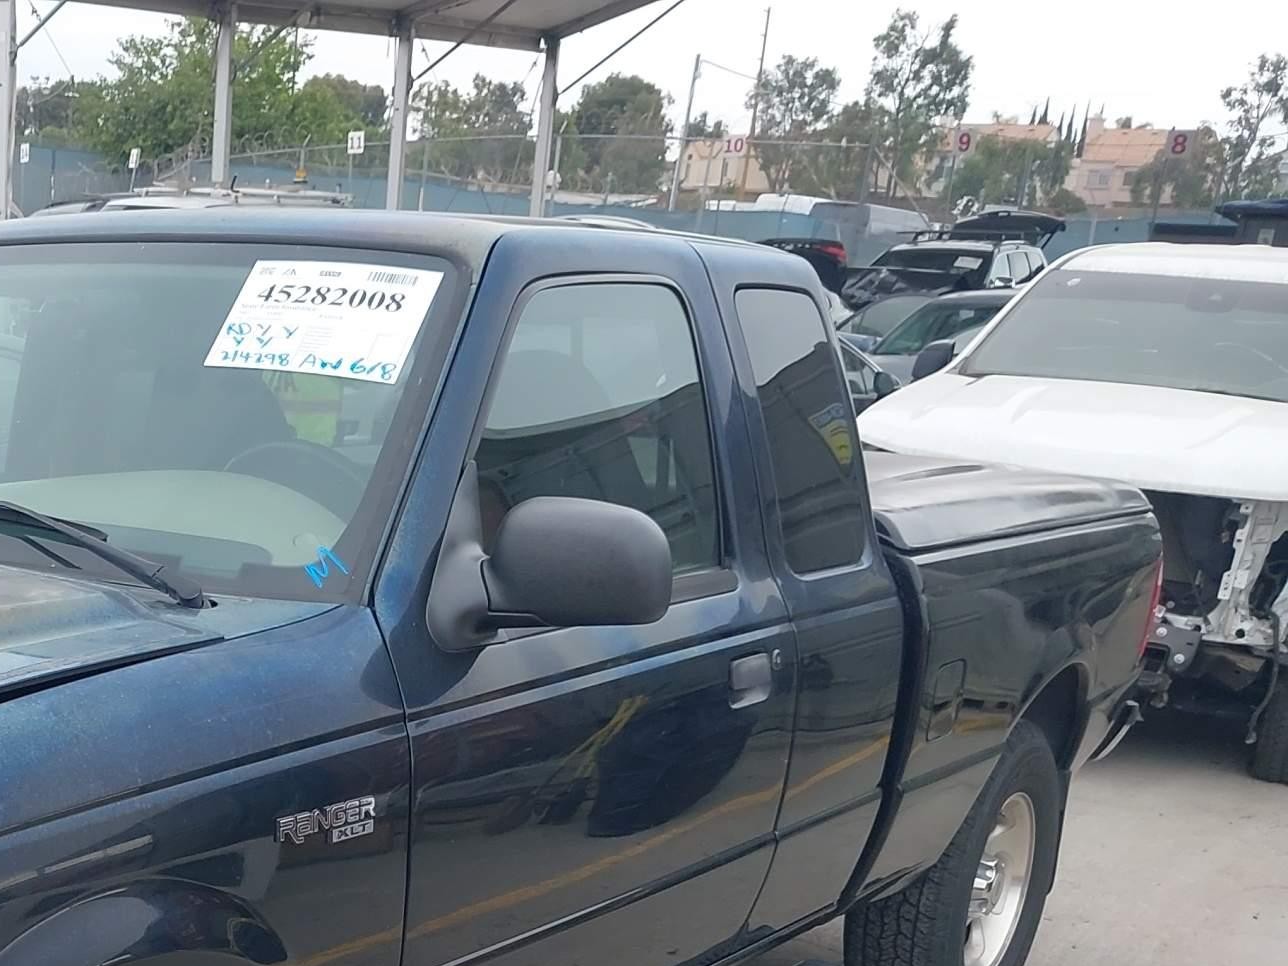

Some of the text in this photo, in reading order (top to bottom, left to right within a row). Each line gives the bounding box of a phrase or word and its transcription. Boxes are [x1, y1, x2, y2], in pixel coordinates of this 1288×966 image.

[349, 136, 361, 149] 11
[724, 138, 744, 153] 10
[958, 133, 971, 152] 9
[1170, 133, 1188, 155] 8
[257, 283, 406, 313] 45282008
[276, 796, 376, 844] RANGER
[335, 821, 372, 841] XLT
